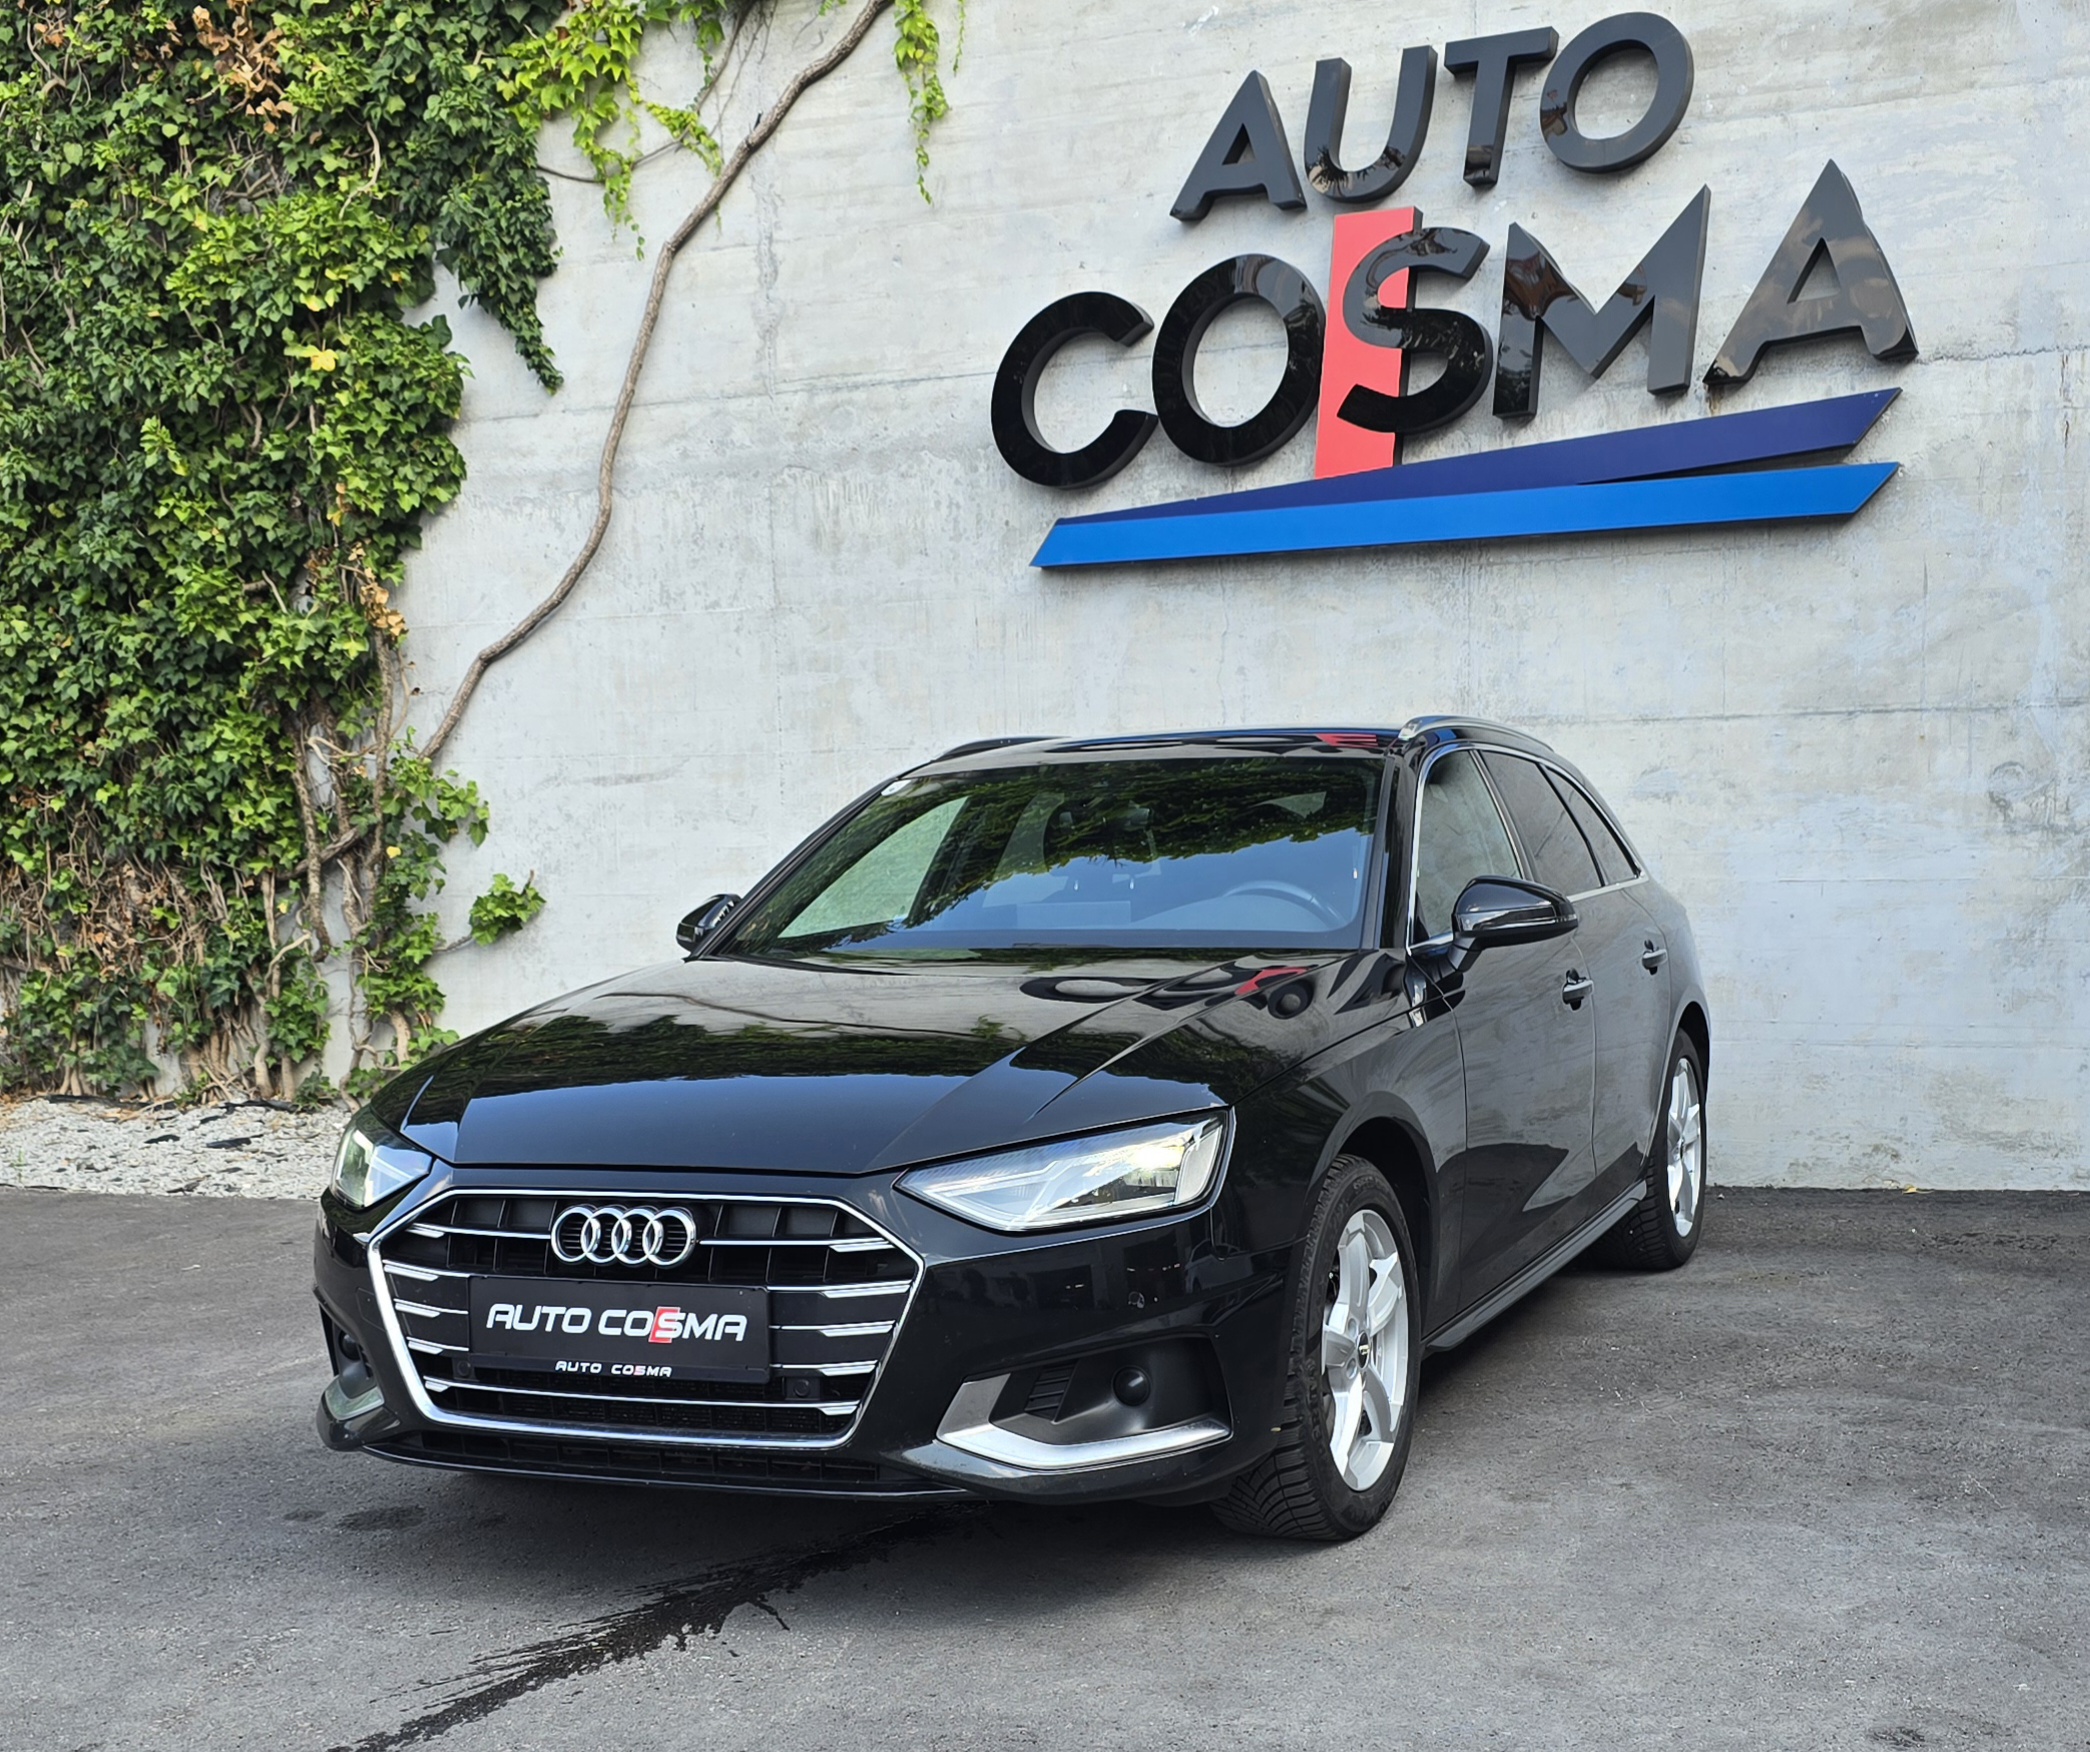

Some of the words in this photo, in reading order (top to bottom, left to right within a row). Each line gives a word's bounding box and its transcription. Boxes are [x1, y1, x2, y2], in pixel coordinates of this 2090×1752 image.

[1169, 11, 1694, 223] AUTO
[990, 159, 1919, 490] COSMA
[486, 1303, 592, 1334] AUTO
[598, 1308, 747, 1342] COSMA
[555, 1361, 602, 1374] AUTO
[611, 1363, 672, 1378] COSMA
